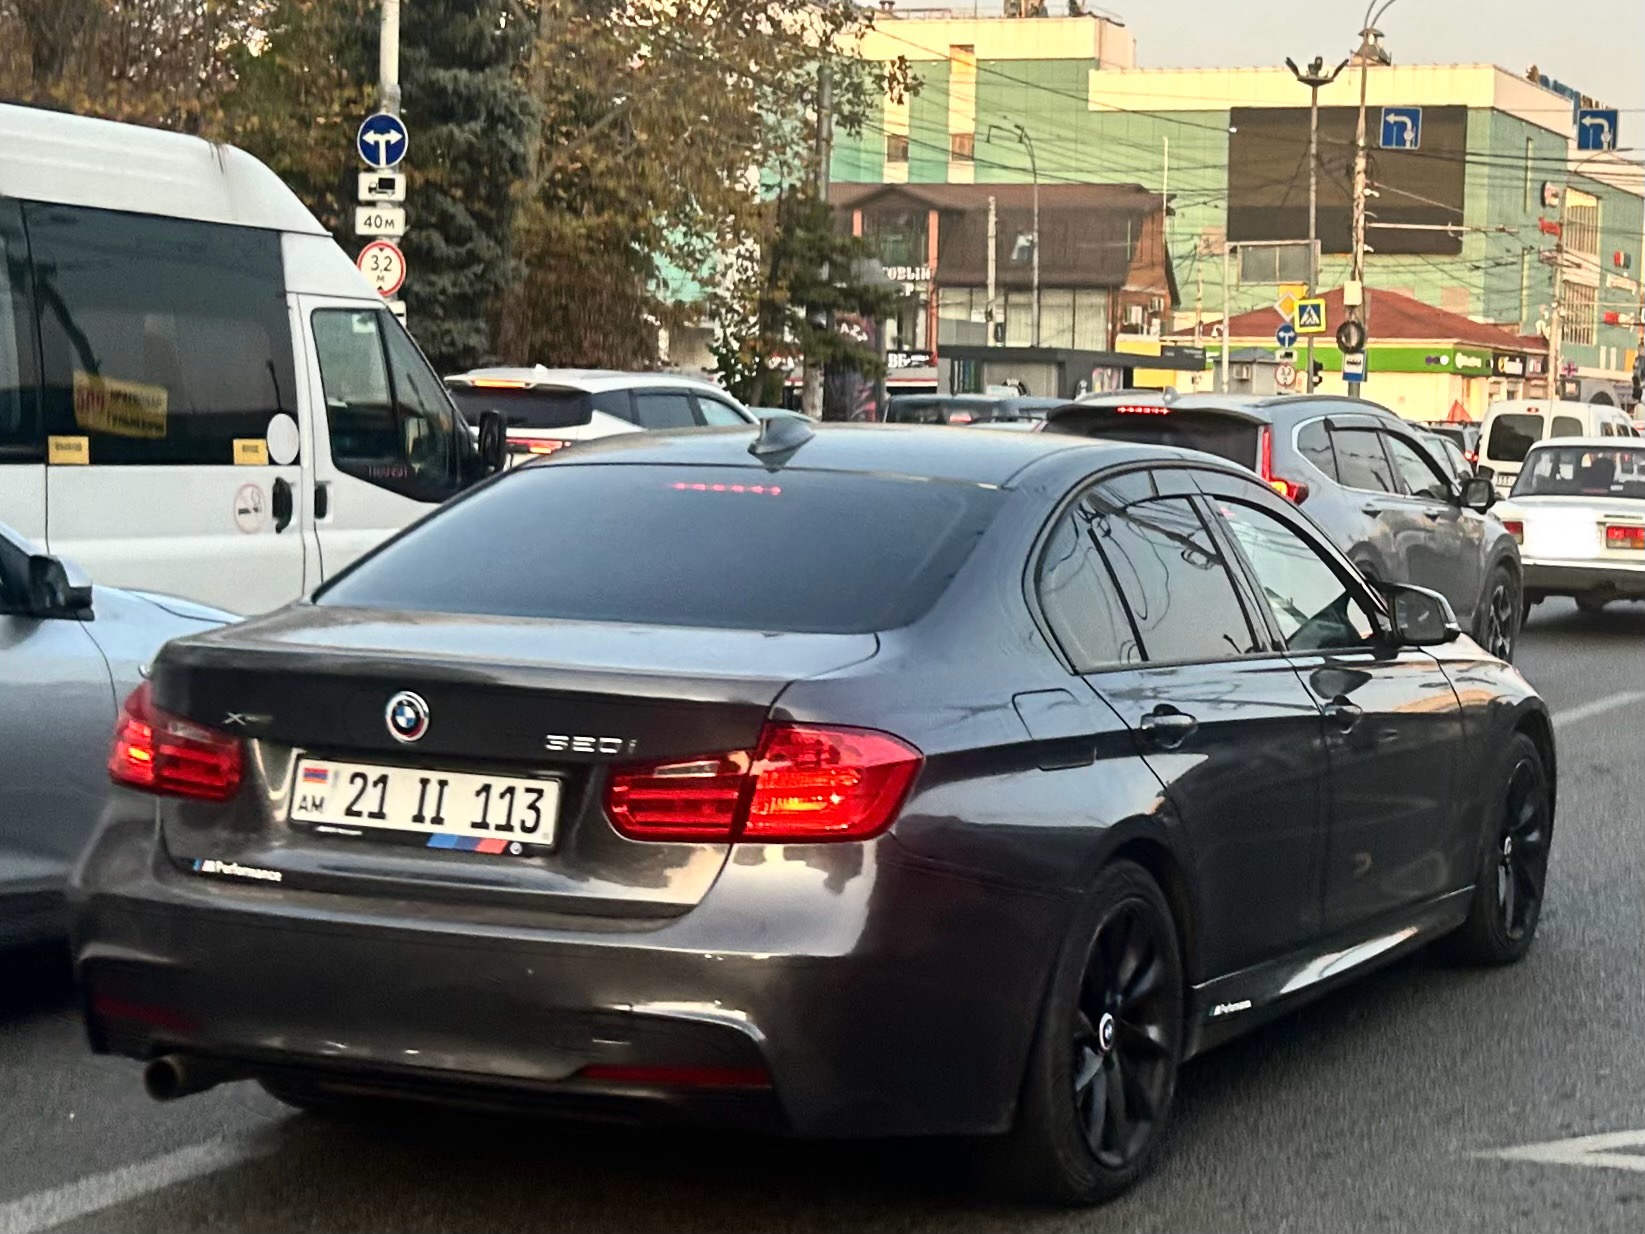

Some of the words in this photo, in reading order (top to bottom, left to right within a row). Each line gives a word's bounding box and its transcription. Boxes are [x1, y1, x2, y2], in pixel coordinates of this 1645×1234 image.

[298, 794, 325, 813] AM
[344, 771, 389, 820] 21
[411, 777, 449, 825] II
[469, 783, 545, 834] 113
